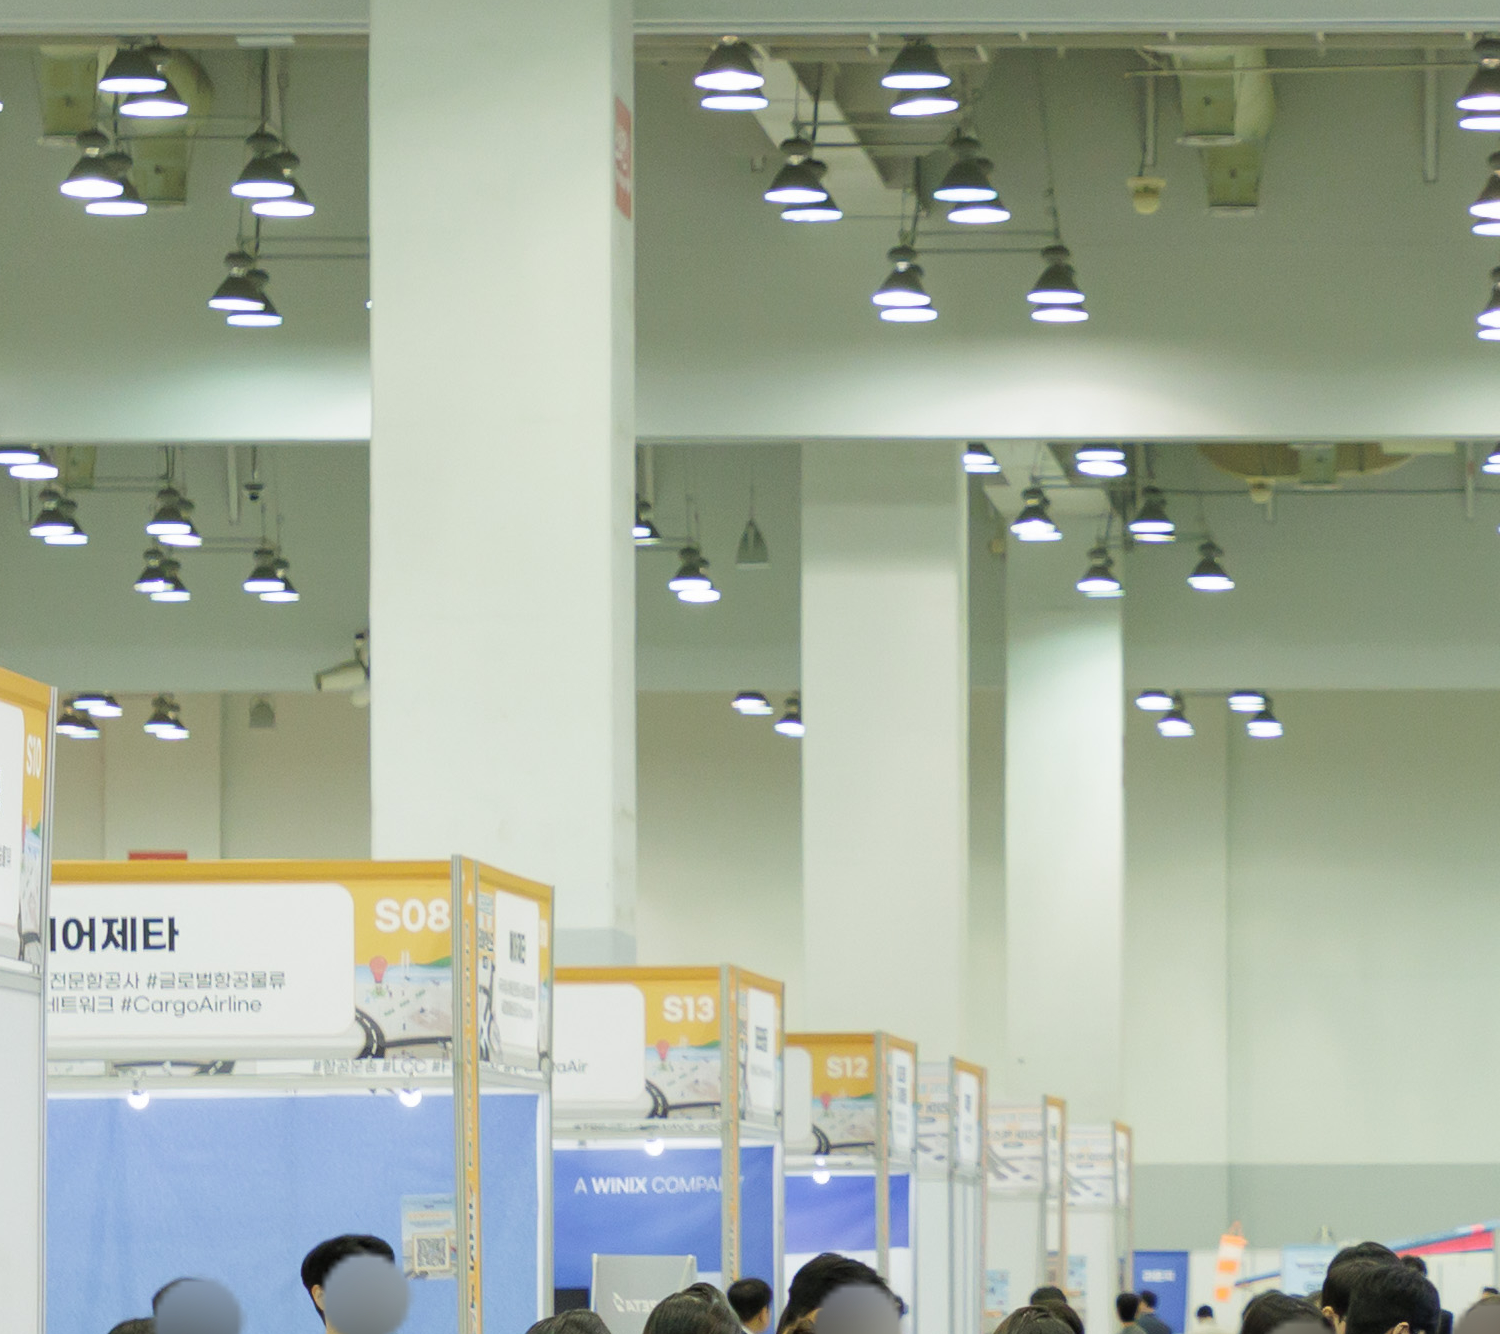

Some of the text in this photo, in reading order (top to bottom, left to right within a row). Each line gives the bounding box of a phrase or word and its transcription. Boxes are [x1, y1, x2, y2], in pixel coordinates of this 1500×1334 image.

[375, 898, 450, 934] S08
[120, 995, 262, 1018] #CargoAirline
[662, 994, 715, 1024] S13
[826, 1055, 870, 1079] S12
[574, 1176, 744, 1195] A WINIX COMPA
